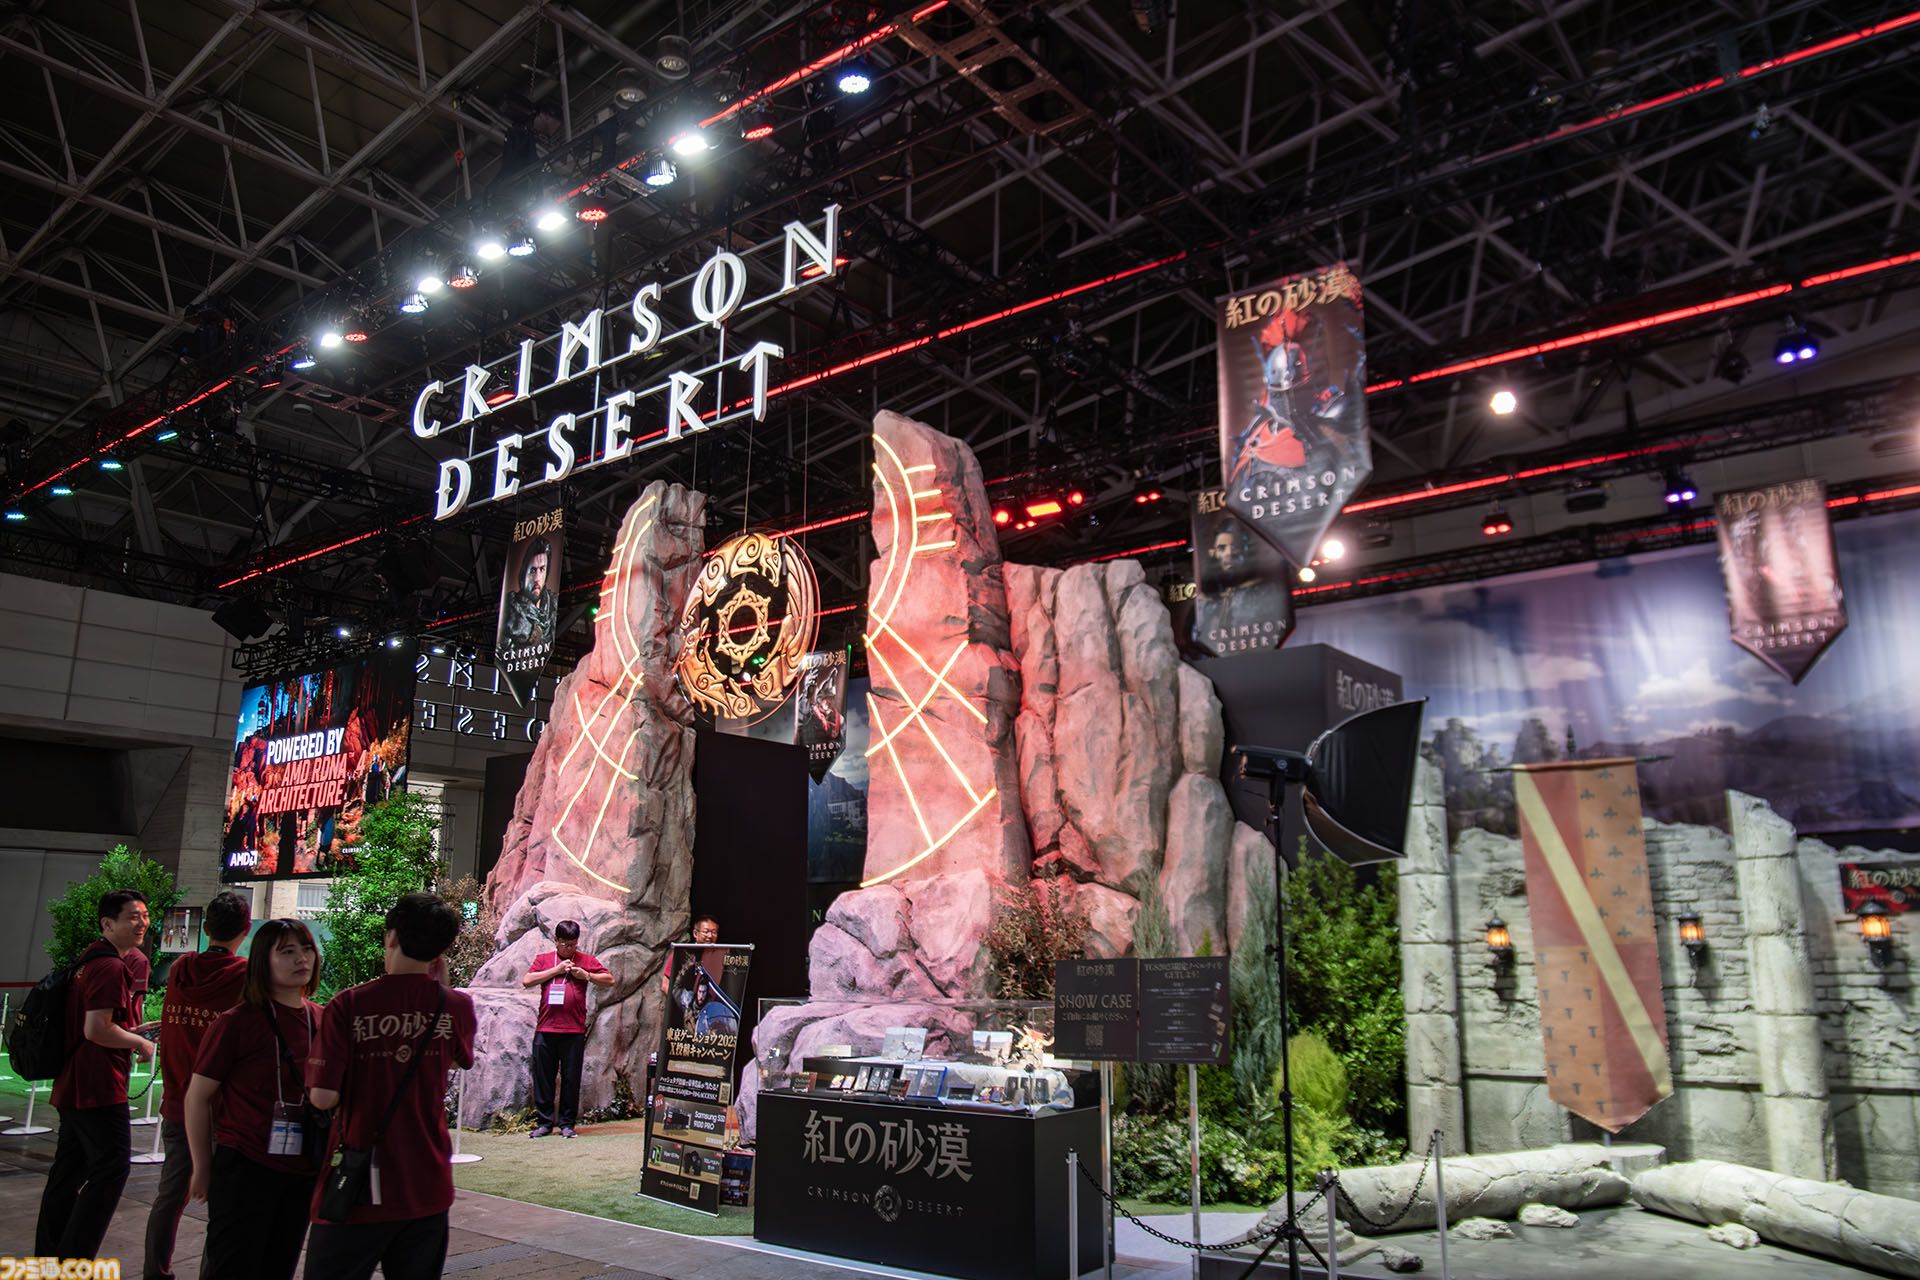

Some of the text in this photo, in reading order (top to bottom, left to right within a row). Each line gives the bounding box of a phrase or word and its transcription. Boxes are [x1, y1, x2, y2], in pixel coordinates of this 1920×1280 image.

[1225, 267, 1354, 330] 紅の砂漠
[412, 203, 843, 440] CRIMSON
[434, 341, 784, 521] DESERT
[1240, 466, 1357, 502] CRIMSON
[1252, 488, 1346, 520] DESERT
[512, 508, 564, 542] 紅の砂漠
[1208, 619, 1287, 641] CRIMSON
[1218, 635, 1280, 653] DESERT
[503, 642, 550, 661] CRIMSON
[507, 657, 545, 673] DESERT
[266, 727, 345, 766] POWERED BY
[281, 760, 312, 787] AMD
[357, 750, 367, 777] 4
[257, 779, 346, 814] ARCHITECTURE
[230, 852, 250, 867] AMD
[1059, 993, 1098, 1009] SHOW
[1101, 993, 1132, 1009] CASE
[352, 1011, 453, 1043] 紅の砂漠
[694, 1110, 718, 1123] Samsung
[703, 1122, 715, 1131] PRO
[802, 1109, 974, 1183] 紅の砂漠
[807, 1186, 964, 1217] CRIMSON DESERT
